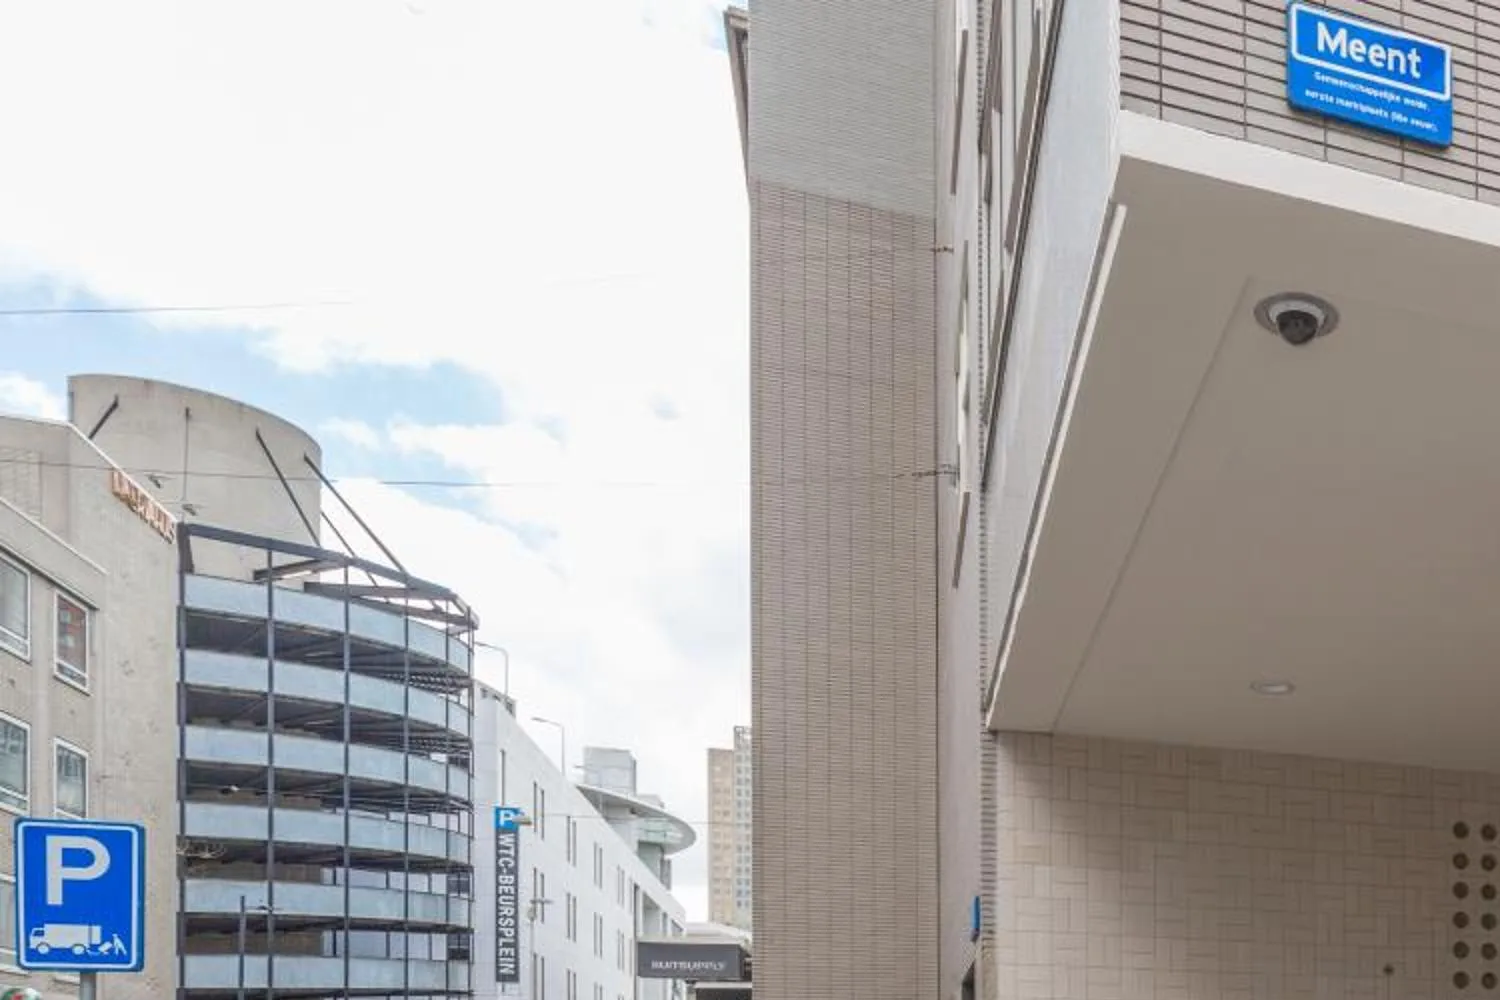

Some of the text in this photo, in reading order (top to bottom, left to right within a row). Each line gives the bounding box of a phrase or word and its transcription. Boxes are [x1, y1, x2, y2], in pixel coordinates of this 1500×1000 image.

[1317, 21, 1421, 79] Meent
[45, 834, 111, 906] P
[498, 833, 516, 975] WTC-BEURSPLEIN
